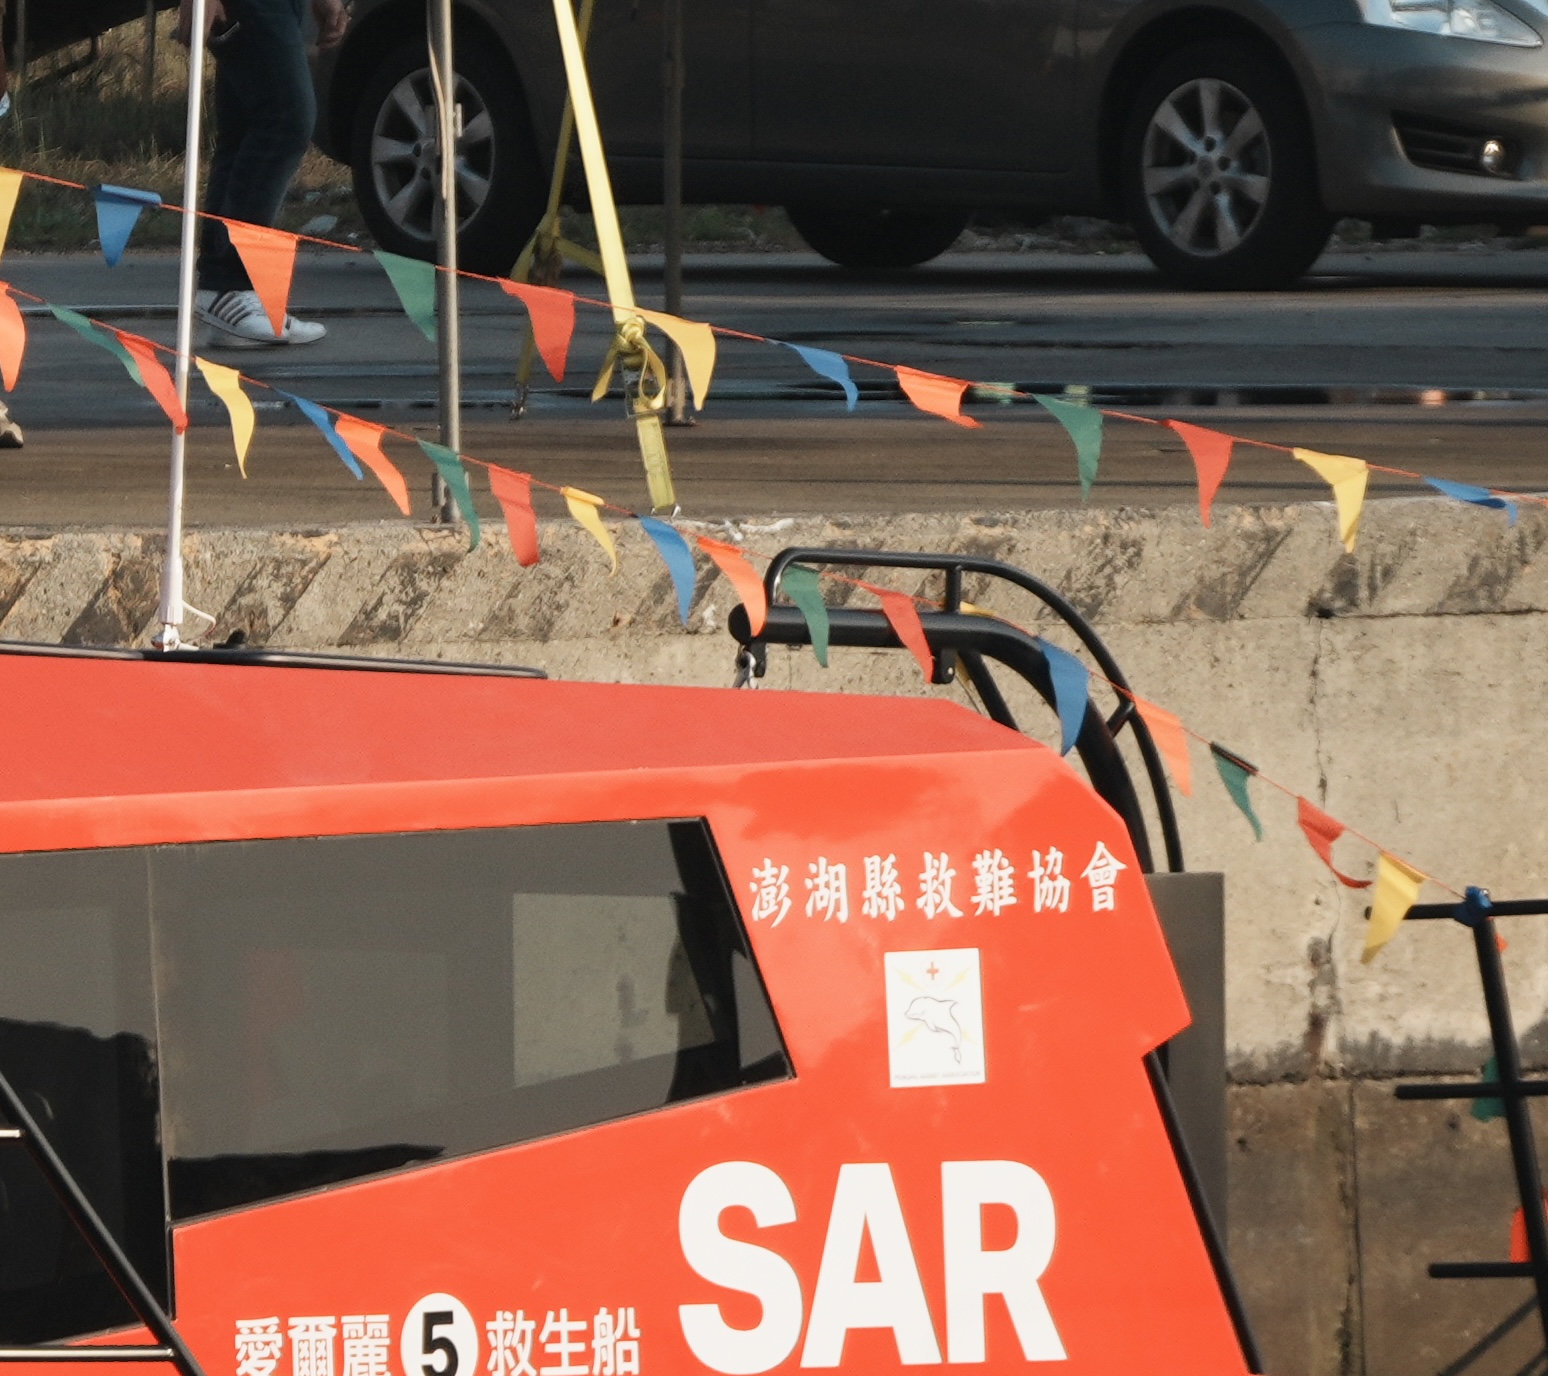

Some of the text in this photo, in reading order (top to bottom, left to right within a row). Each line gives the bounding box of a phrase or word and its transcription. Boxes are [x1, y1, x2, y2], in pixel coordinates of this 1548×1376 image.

[749, 841, 1127, 928] 澎湖縣救難協會
[679, 1160, 1068, 1375] SAR
